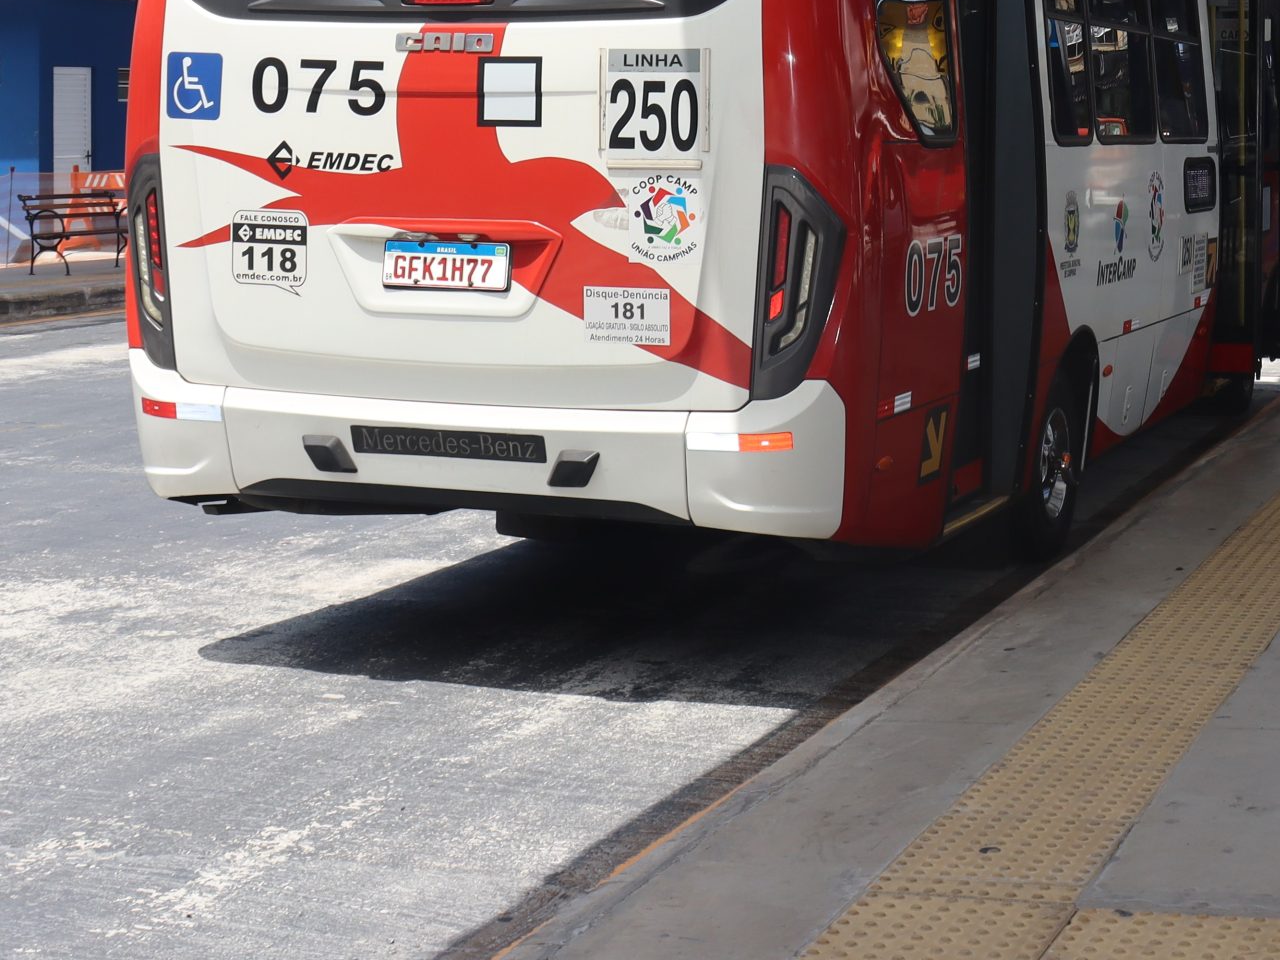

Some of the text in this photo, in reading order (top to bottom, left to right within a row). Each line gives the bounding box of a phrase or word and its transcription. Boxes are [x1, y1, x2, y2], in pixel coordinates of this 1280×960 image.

[395, 32, 494, 53] CAIO
[623, 53, 684, 68] LINHA
[252, 56, 386, 117] 075
[608, 78, 699, 152] 250
[306, 151, 394, 173] EMDEC
[632, 175, 698, 195] COOP CAMP
[240, 214, 299, 223] FALE CONOSCO
[255, 228, 302, 241] EMDEC
[241, 246, 297, 273] 118
[631, 241, 697, 262] UNIÃO CAMPINAS
[236, 272, 302, 282] emdec.com.br
[393, 255, 493, 283] GFK1H77
[905, 234, 962, 317] 075
[585, 289, 668, 300] Disque-Denúncia
[611, 302, 645, 320] 181
[590, 333, 633, 343] Atendimento
[634, 335, 643, 343] 24
[360, 428, 537, 459] Mercedes-Benz
